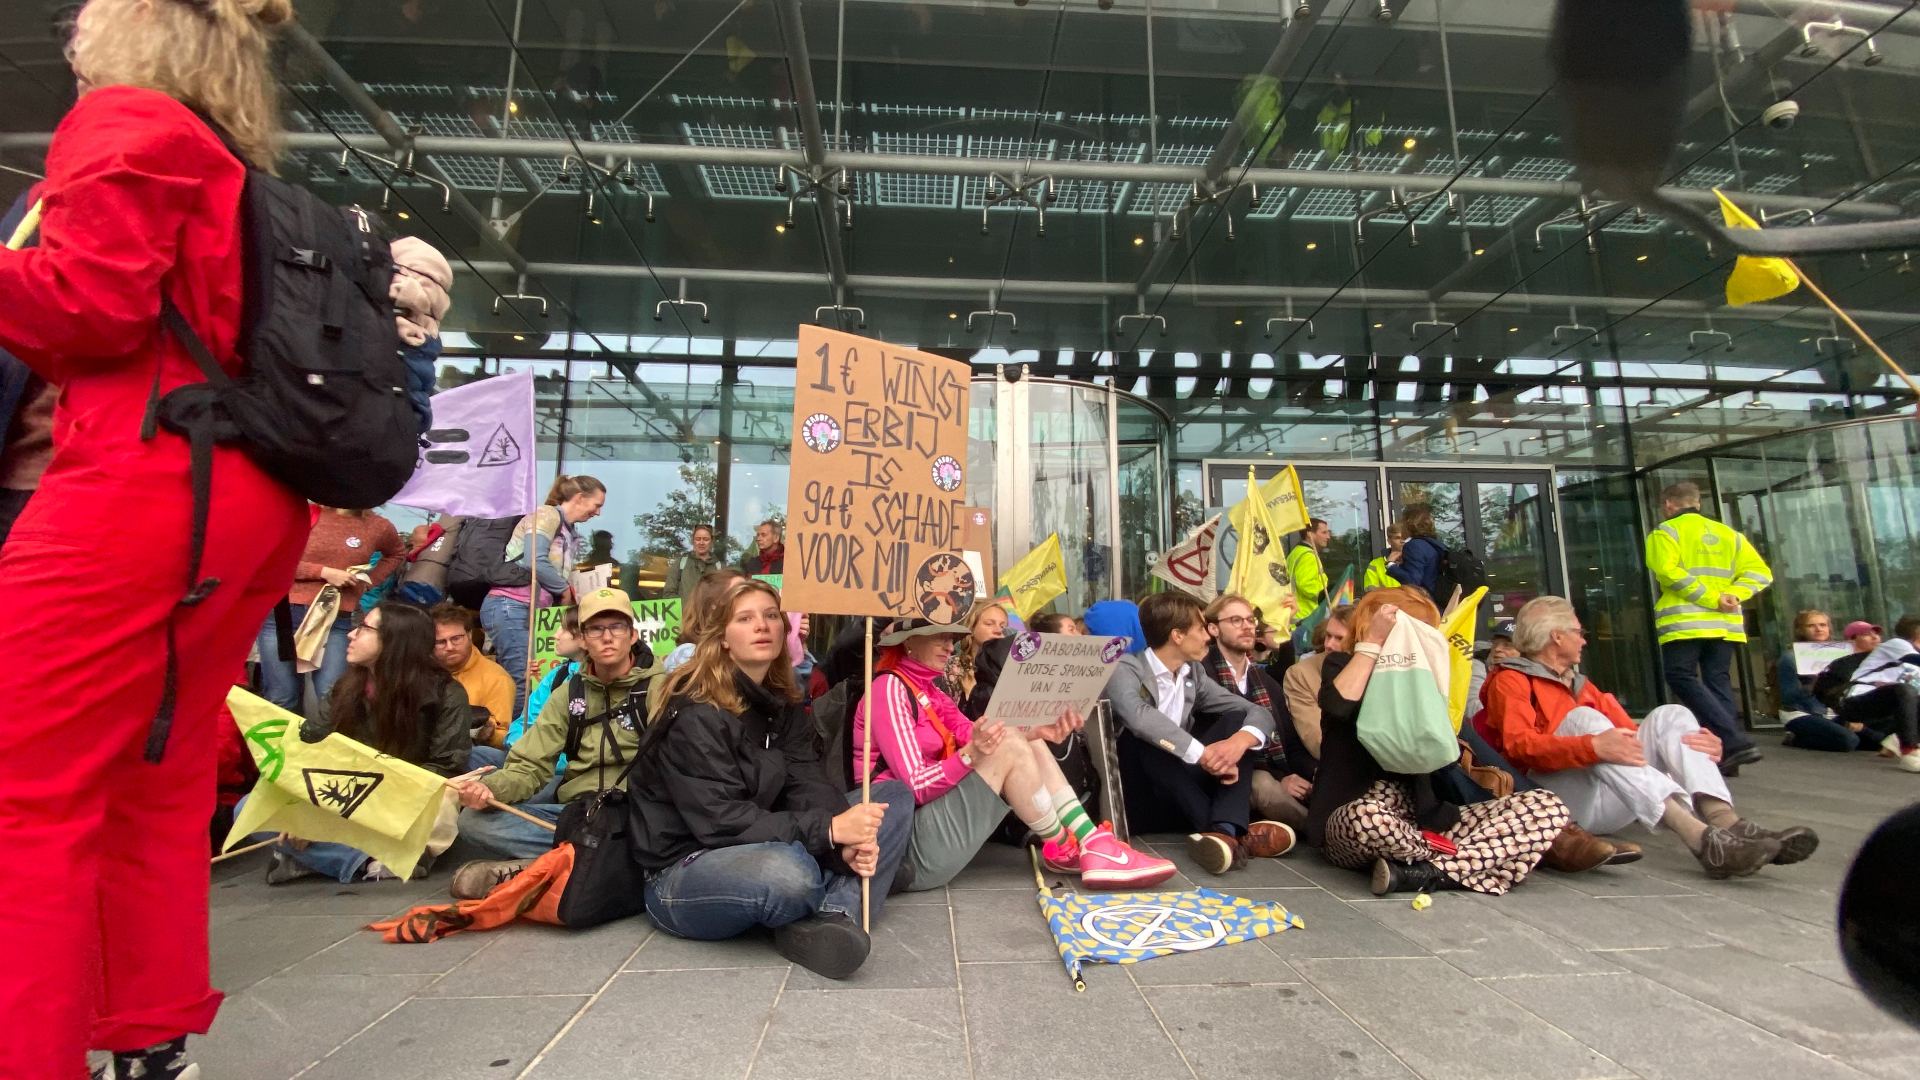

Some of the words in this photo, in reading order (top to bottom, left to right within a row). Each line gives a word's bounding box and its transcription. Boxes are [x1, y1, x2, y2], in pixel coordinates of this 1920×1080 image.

[880, 350, 968, 427] WINST
[843, 401, 939, 459] ERBIJ
[847, 449, 903, 490] IS
[864, 492, 965, 552] SCHADE
[797, 532, 864, 589] VOOR
[871, 539, 910, 610] MIJ
[1017, 662, 1059, 676] TROTSE
[1060, 663, 1105, 677] SPONSOR
[1041, 641, 1102, 657] RABOBANK
[1030, 681, 1052, 693] VAN
[1058, 682, 1073, 693] DE
